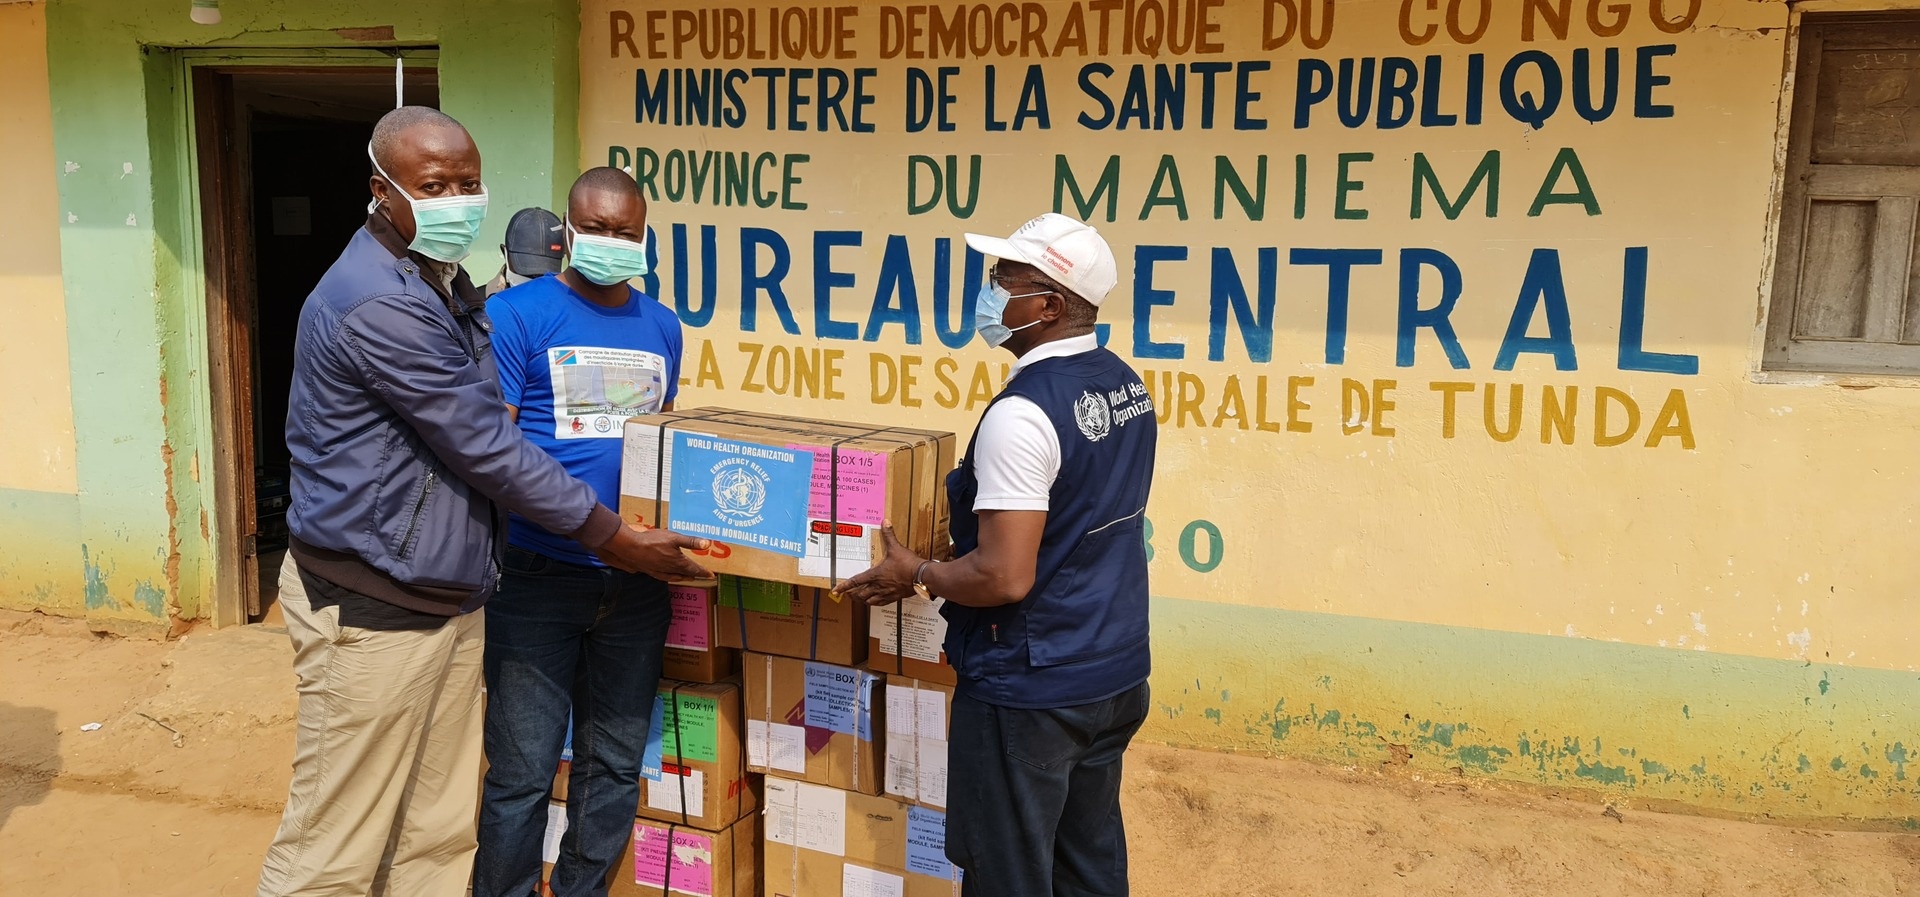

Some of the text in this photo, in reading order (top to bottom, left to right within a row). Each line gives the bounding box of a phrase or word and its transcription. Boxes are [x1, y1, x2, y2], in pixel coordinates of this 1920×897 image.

[610, 0, 1702, 61] REPUBLIQUE DEMOCRATIQUE DU CONGO
[635, 44, 1677, 133] MINISTERE DE LA SANTE PUBLIQUE
[907, 154, 982, 219] DU
[1053, 148, 1603, 222] MANIEMA
[1046, 246, 1074, 268] Eliminons
[1095, 245, 1699, 375] ENTRAL
[738, 341, 845, 400] ZONE
[869, 352, 923, 409] DE
[1143, 369, 1315, 435] URALE
[1341, 377, 1398, 438] DE
[1429, 381, 1697, 449] TUNDA
[1127, 382, 1148, 398] Hea
[687, 437, 795, 463] WORLD HEALTH ORGANIZATION
[859, 457, 873, 467] 1/5
[710, 457, 771, 483] EMERGENCY RELIEF
[852, 477, 876, 485] CASES)
[713, 508, 764, 528] AIDE D'URGENCE
[672, 519, 720, 536] ORGANISATION
[722, 527, 757, 543] MONDIALE
[759, 534, 768, 545] DE
[769, 537, 779, 547] LA
[780, 538, 802, 552] SANTE
[835, 673, 855, 684] BOX
[683, 701, 714, 713] BOX 1/1
